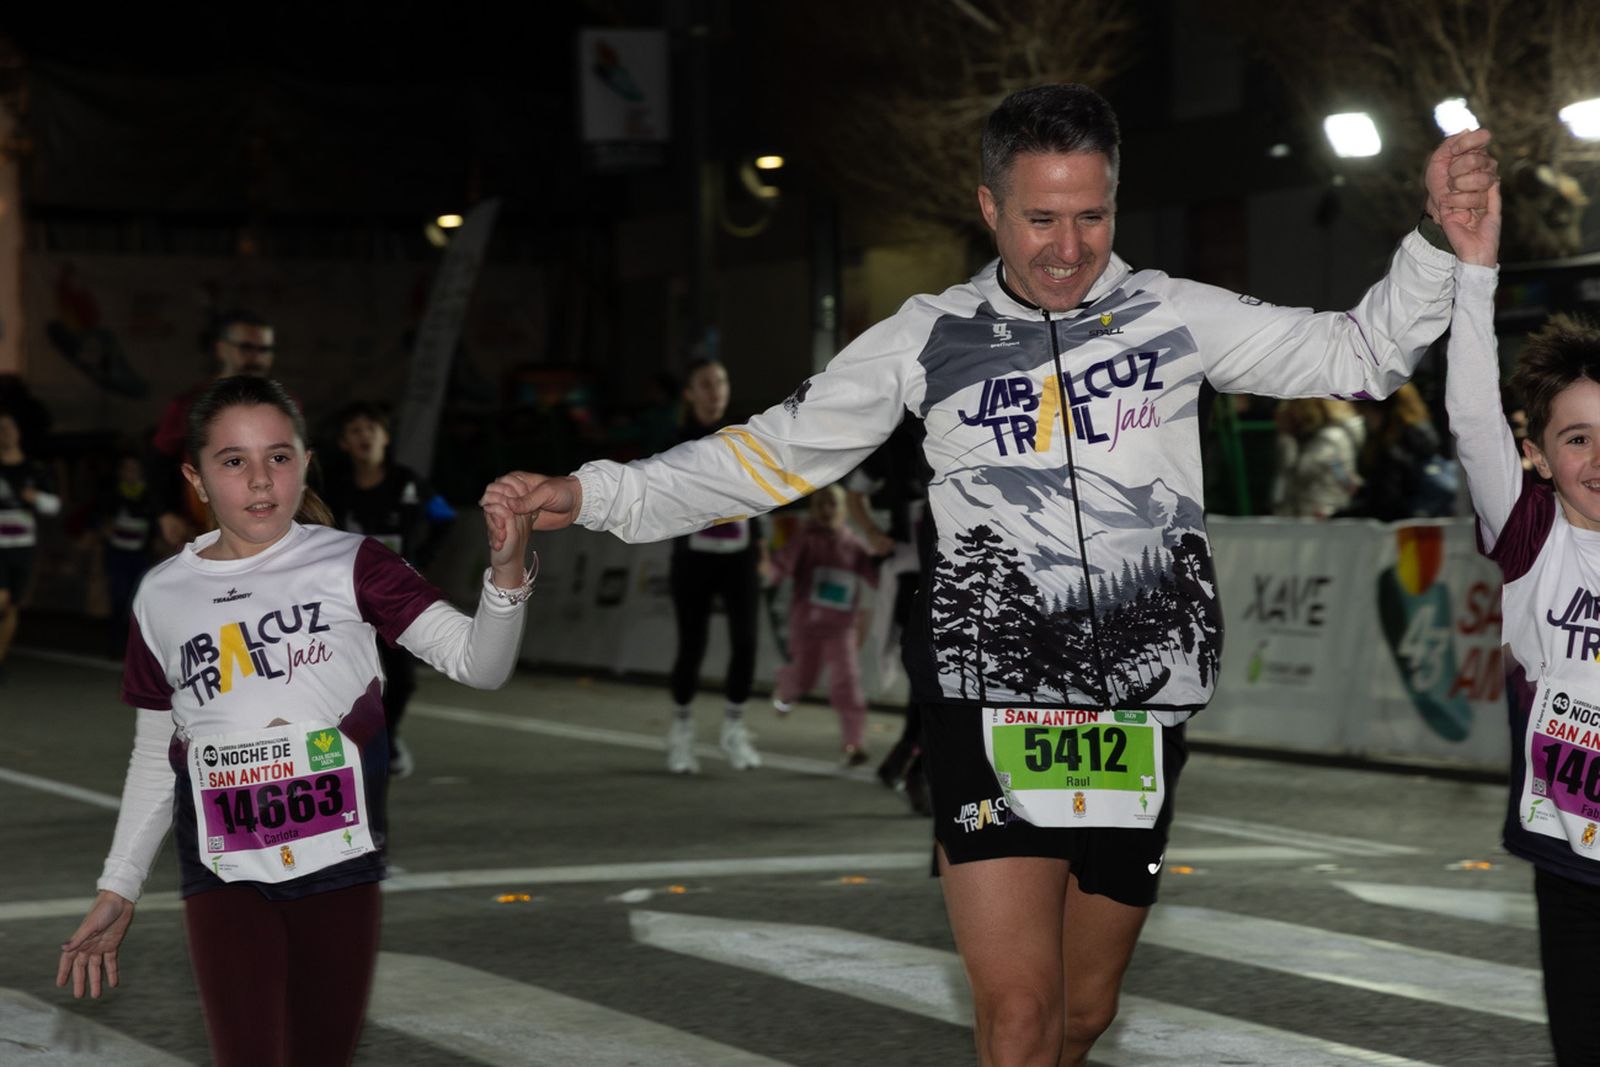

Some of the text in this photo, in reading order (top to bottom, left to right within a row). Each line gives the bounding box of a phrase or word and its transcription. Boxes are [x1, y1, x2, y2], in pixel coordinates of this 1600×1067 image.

[1088, 328, 1123, 336] SPALL
[958, 351, 1164, 428] JABALCUZ
[982, 397, 1161, 456] TRAIL Jaén
[177, 602, 331, 690] JABALCUZ
[1561, 623, 1600, 662] TR
[187, 637, 333, 707] TRAIL Jaén
[1552, 697, 1568, 711] 43
[1004, 708, 1038, 724] SAN
[1569, 706, 1600, 728] NOC
[1546, 719, 1579, 742] SAN
[203, 750, 217, 761] 43
[221, 743, 291, 766] NOCHE DE
[1024, 727, 1128, 772] 5412
[209, 760, 294, 787] SAN ANTÓN
[1066, 776, 1090, 787] Raul
[214, 774, 344, 834] 14663
[263, 829, 299, 845] Carlota
